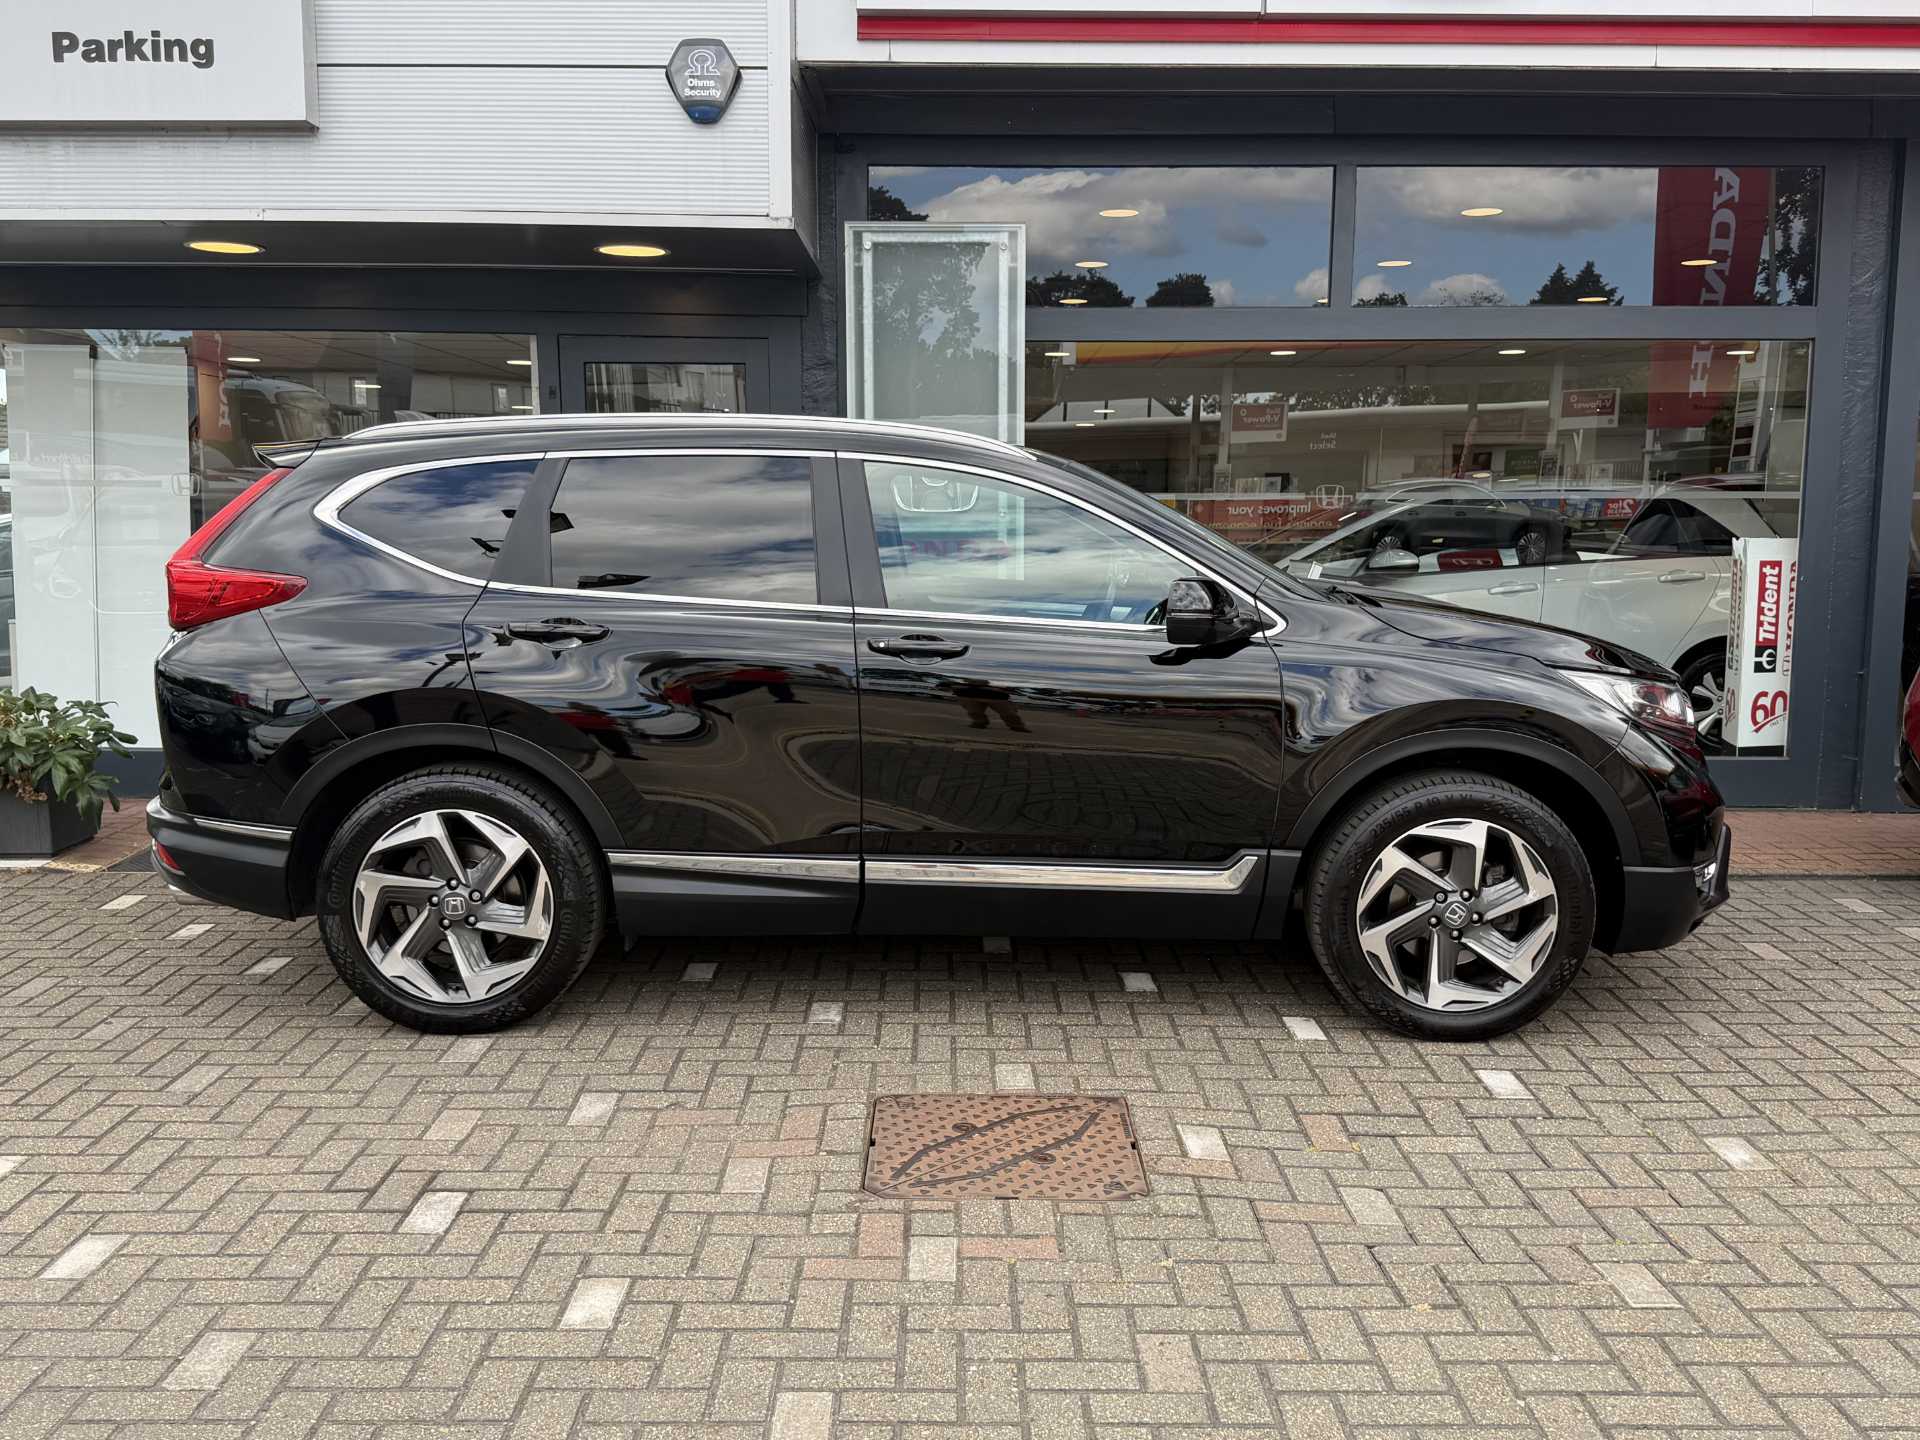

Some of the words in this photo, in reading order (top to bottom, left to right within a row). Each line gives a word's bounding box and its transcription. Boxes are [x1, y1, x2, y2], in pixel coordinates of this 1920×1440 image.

[52, 30, 214, 69] Parking
[684, 88, 721, 98] Security
[687, 78, 715, 87] Ohms
[1759, 565, 1779, 641] Trident
[1751, 690, 1788, 727] 60
